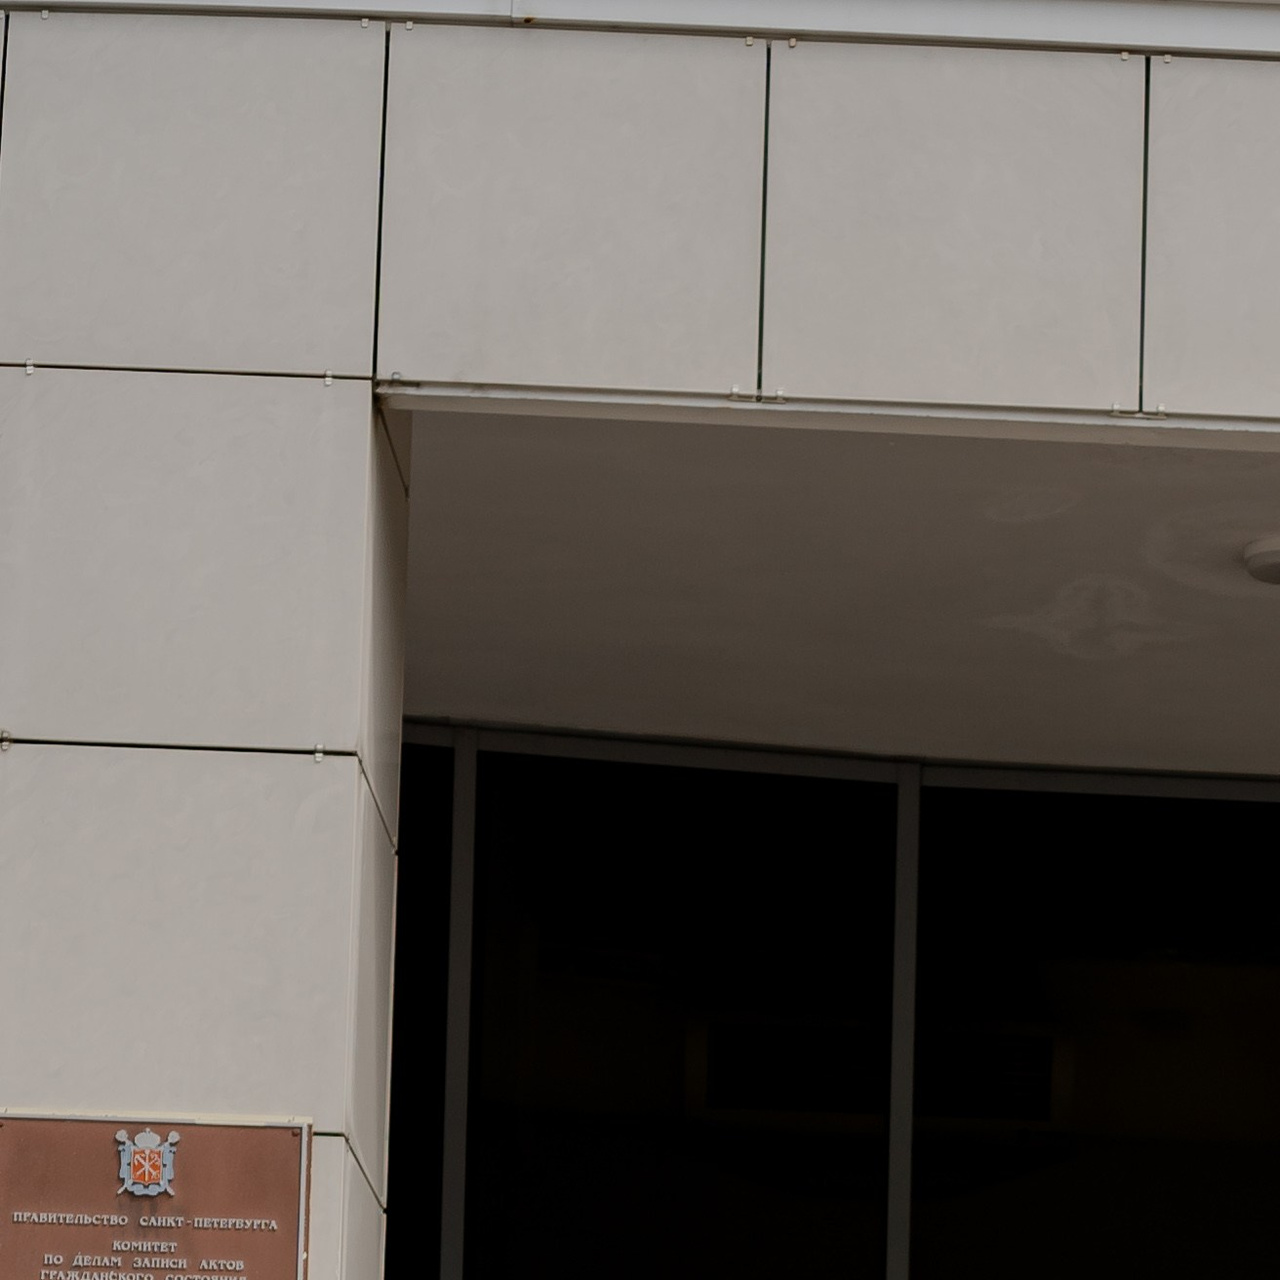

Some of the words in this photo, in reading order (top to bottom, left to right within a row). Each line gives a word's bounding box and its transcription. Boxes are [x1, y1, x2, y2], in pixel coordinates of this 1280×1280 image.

[13, 1211, 129, 1226] ПРАВИТЕЛЬСТВО
[112, 1240, 178, 1253] КОМИТЕТ
[43, 1254, 64, 1266] ПО
[72, 1255, 122, 1268] ДЕЛАМ
[133, 1256, 187, 1269] ЗАПИСИ
[199, 1260, 245, 1271] АКТОВ
